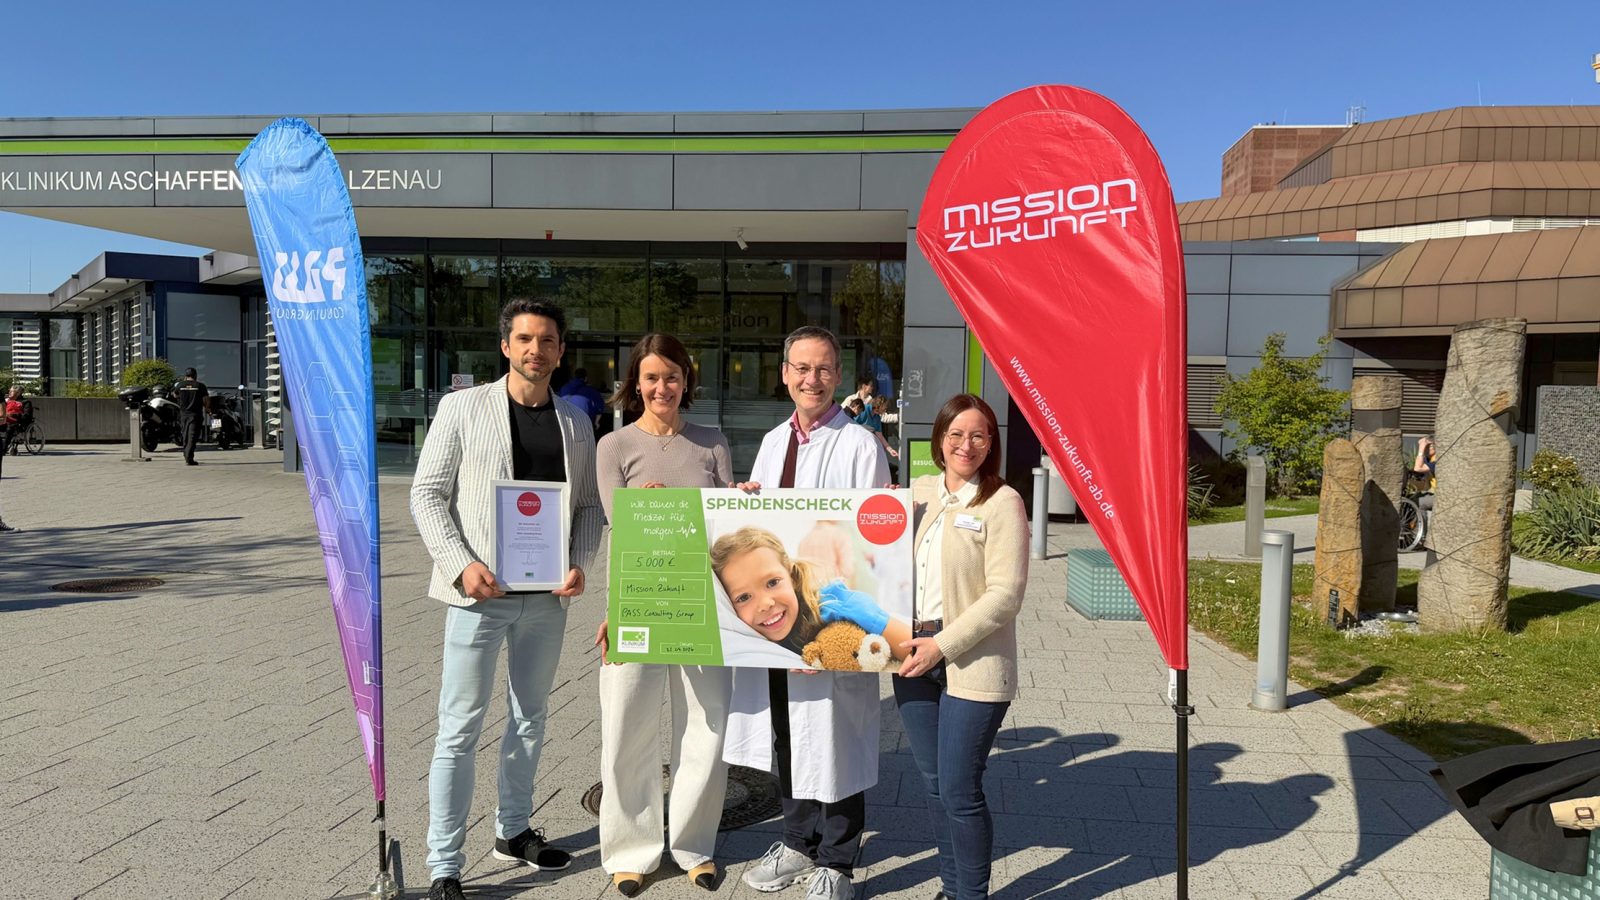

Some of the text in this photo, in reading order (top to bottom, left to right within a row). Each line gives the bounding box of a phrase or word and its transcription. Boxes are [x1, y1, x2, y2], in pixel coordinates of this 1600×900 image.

[1, 169, 442, 191] KLINIKUM ASCHAFFEN LZENAU
[943, 178, 1137, 230] MISSION
[944, 206, 1137, 253] ZUKUNFT
[1009, 356, 1115, 520] www.mission-zukunft-ab.de
[912, 459, 935, 467] BESUC
[706, 497, 852, 511] SPENDENSCHECK
[625, 583, 686, 595] Mission Zukunft
[621, 607, 695, 621] PASS Consulting Group
